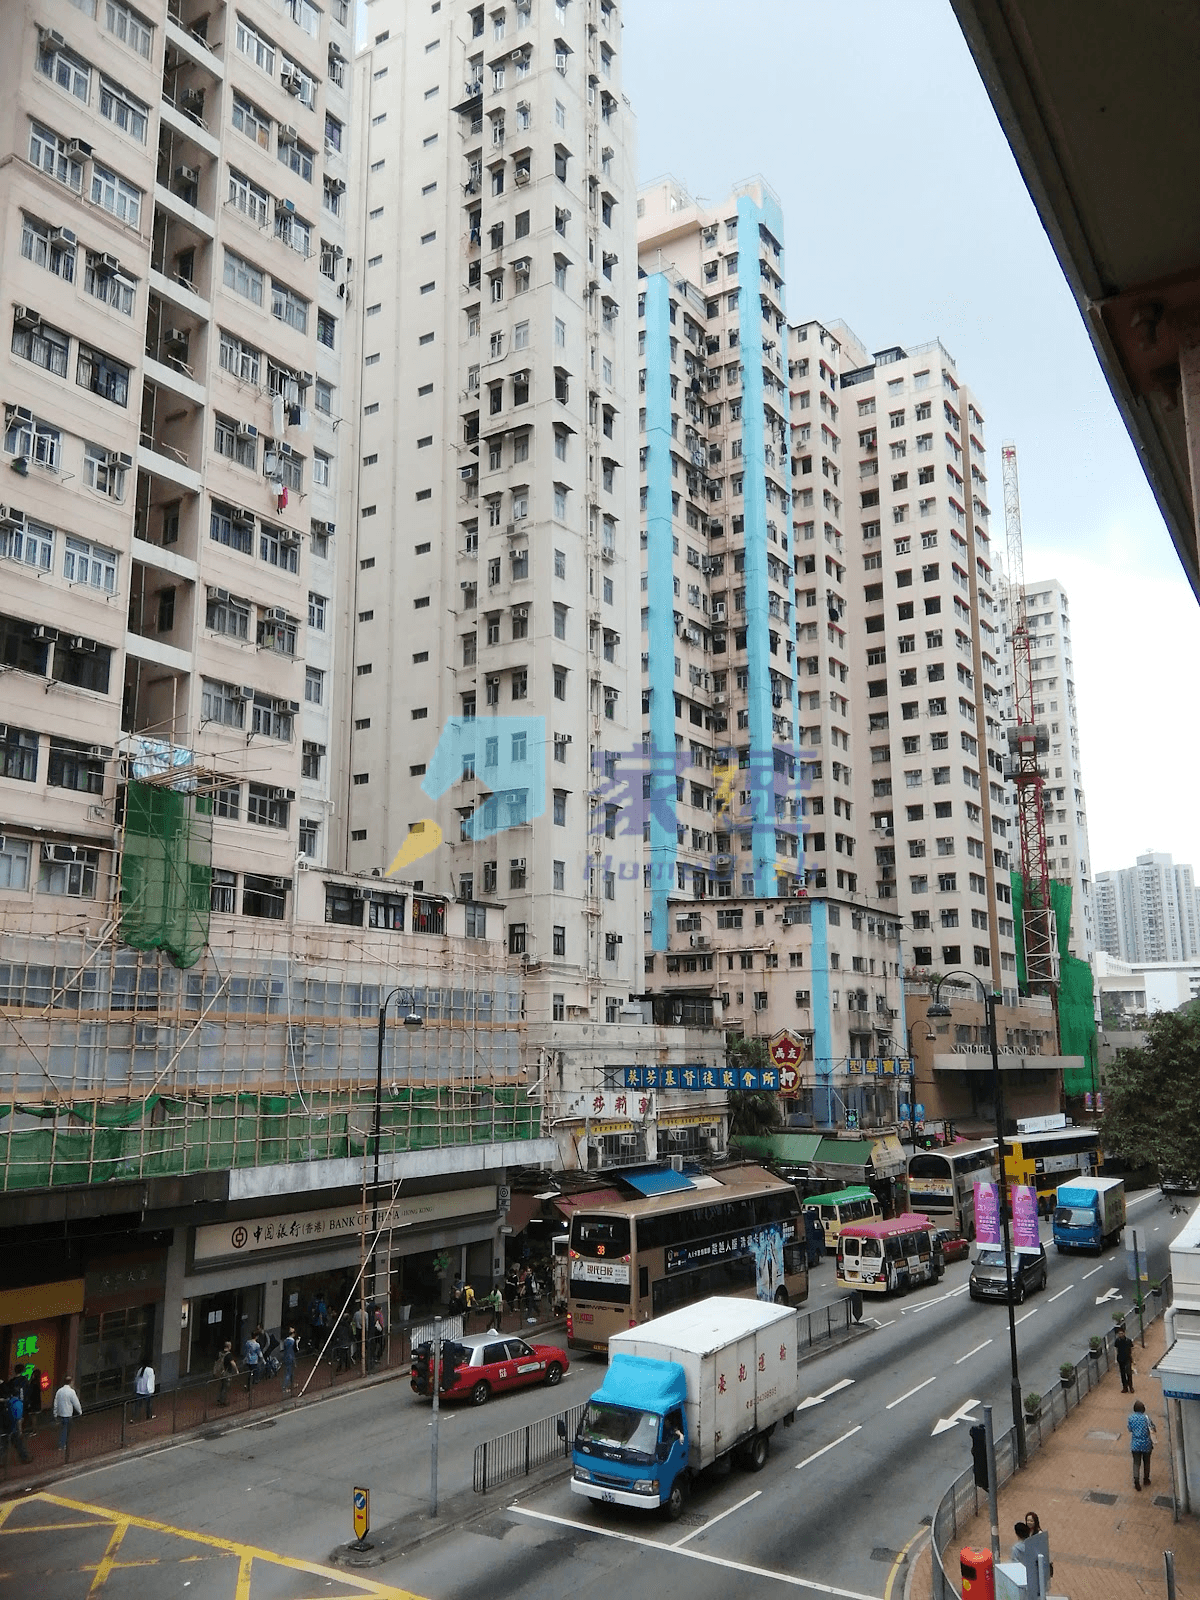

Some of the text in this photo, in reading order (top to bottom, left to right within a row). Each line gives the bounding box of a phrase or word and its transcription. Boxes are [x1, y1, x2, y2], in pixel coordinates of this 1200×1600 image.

[626, 1068, 777, 1088] 葵芳基督徒聚會所
[780, 1067, 796, 1087] 押
[329, 1215, 355, 1231] BANK
[357, 1213, 369, 1228] OF
[372, 1209, 400, 1226] HINA
[597, 1245, 605, 1255] 38
